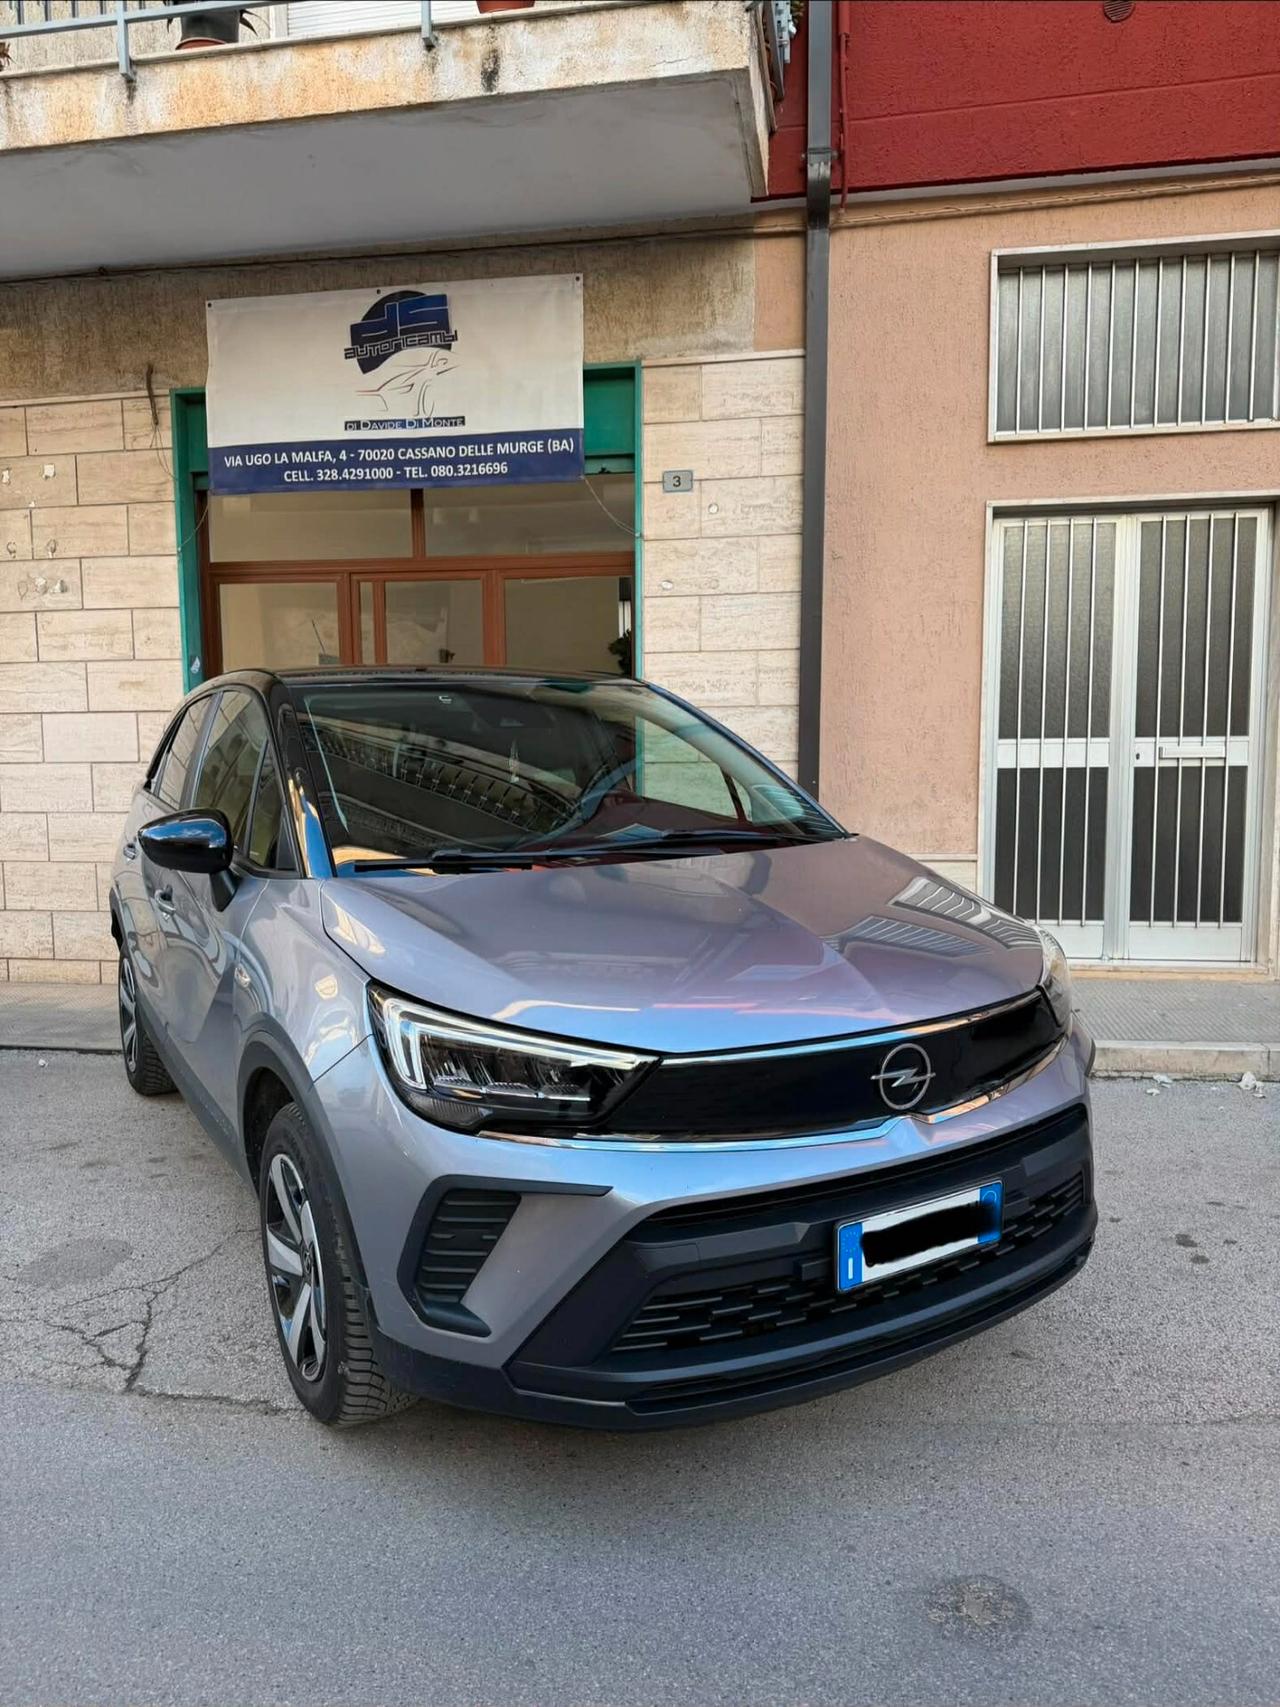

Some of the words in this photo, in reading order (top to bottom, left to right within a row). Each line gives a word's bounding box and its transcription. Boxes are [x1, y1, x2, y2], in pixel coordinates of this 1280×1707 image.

[224, 455, 243, 467] VIA
[245, 453, 271, 466] UGO
[274, 452, 289, 464] LA
[291, 450, 336, 464] MALFA,
[339, 450, 347, 461] 4
[358, 448, 394, 461] 70020
[398, 445, 456, 460] CASSANO
[459, 443, 494, 457] DELLE
[497, 440, 544, 455] MURGE
[547, 437, 574, 454] (BA)
[284, 469, 314, 482] CELL.
[316, 467, 393, 481] 328.4291000
[404, 466, 427, 479] TEL.
[430, 461, 508, 477] 080.3216696
[672, 475, 681, 488] 3
